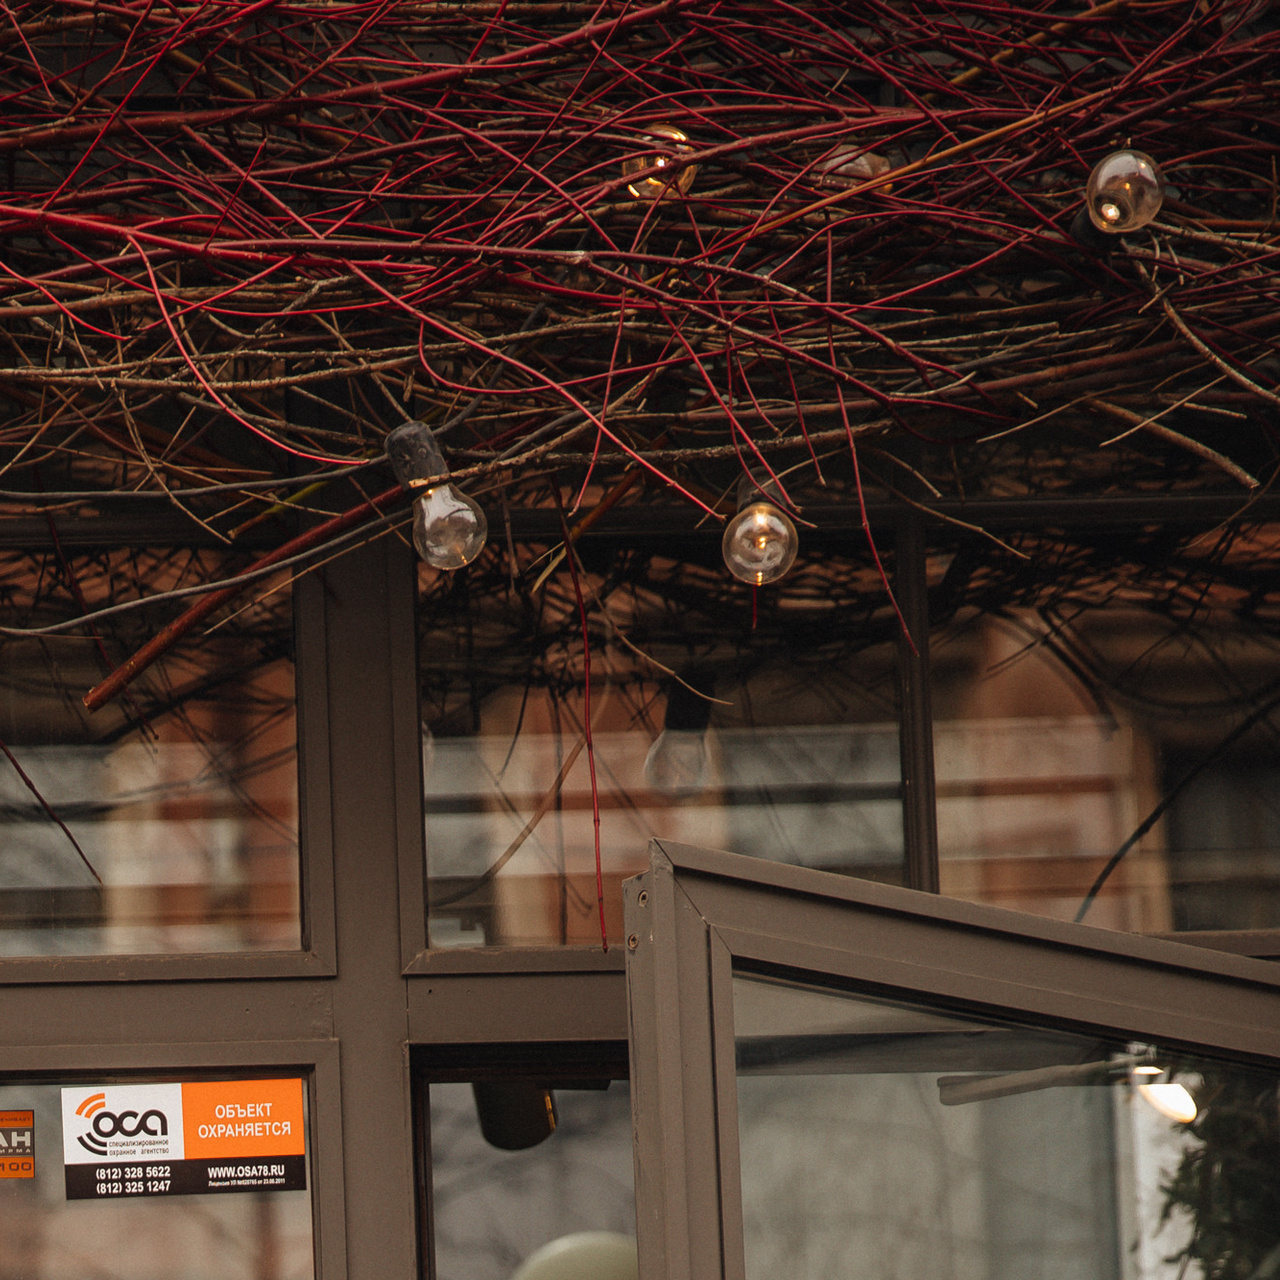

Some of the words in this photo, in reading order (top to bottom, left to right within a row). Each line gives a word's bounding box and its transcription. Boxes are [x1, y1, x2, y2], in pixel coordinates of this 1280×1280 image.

[215, 1102, 272, 1119] ОБЪЕКТ
[198, 1121, 291, 1139] ОХРАНЯЕТСЯ
[108, 1139, 169, 1148] специализированное
[109, 1149, 137, 1157] охранное
[140, 1147, 170, 1155] агентство
[96, 1168, 122, 1180] (812)
[124, 1167, 143, 1178] 328
[146, 1166, 171, 1177] 5622
[207, 1164, 285, 1179] WWW.OSA78.RU
[96, 1182, 122, 1194] (812)
[125, 1182, 144, 1193] 325
[147, 1180, 171, 1192] 1247
